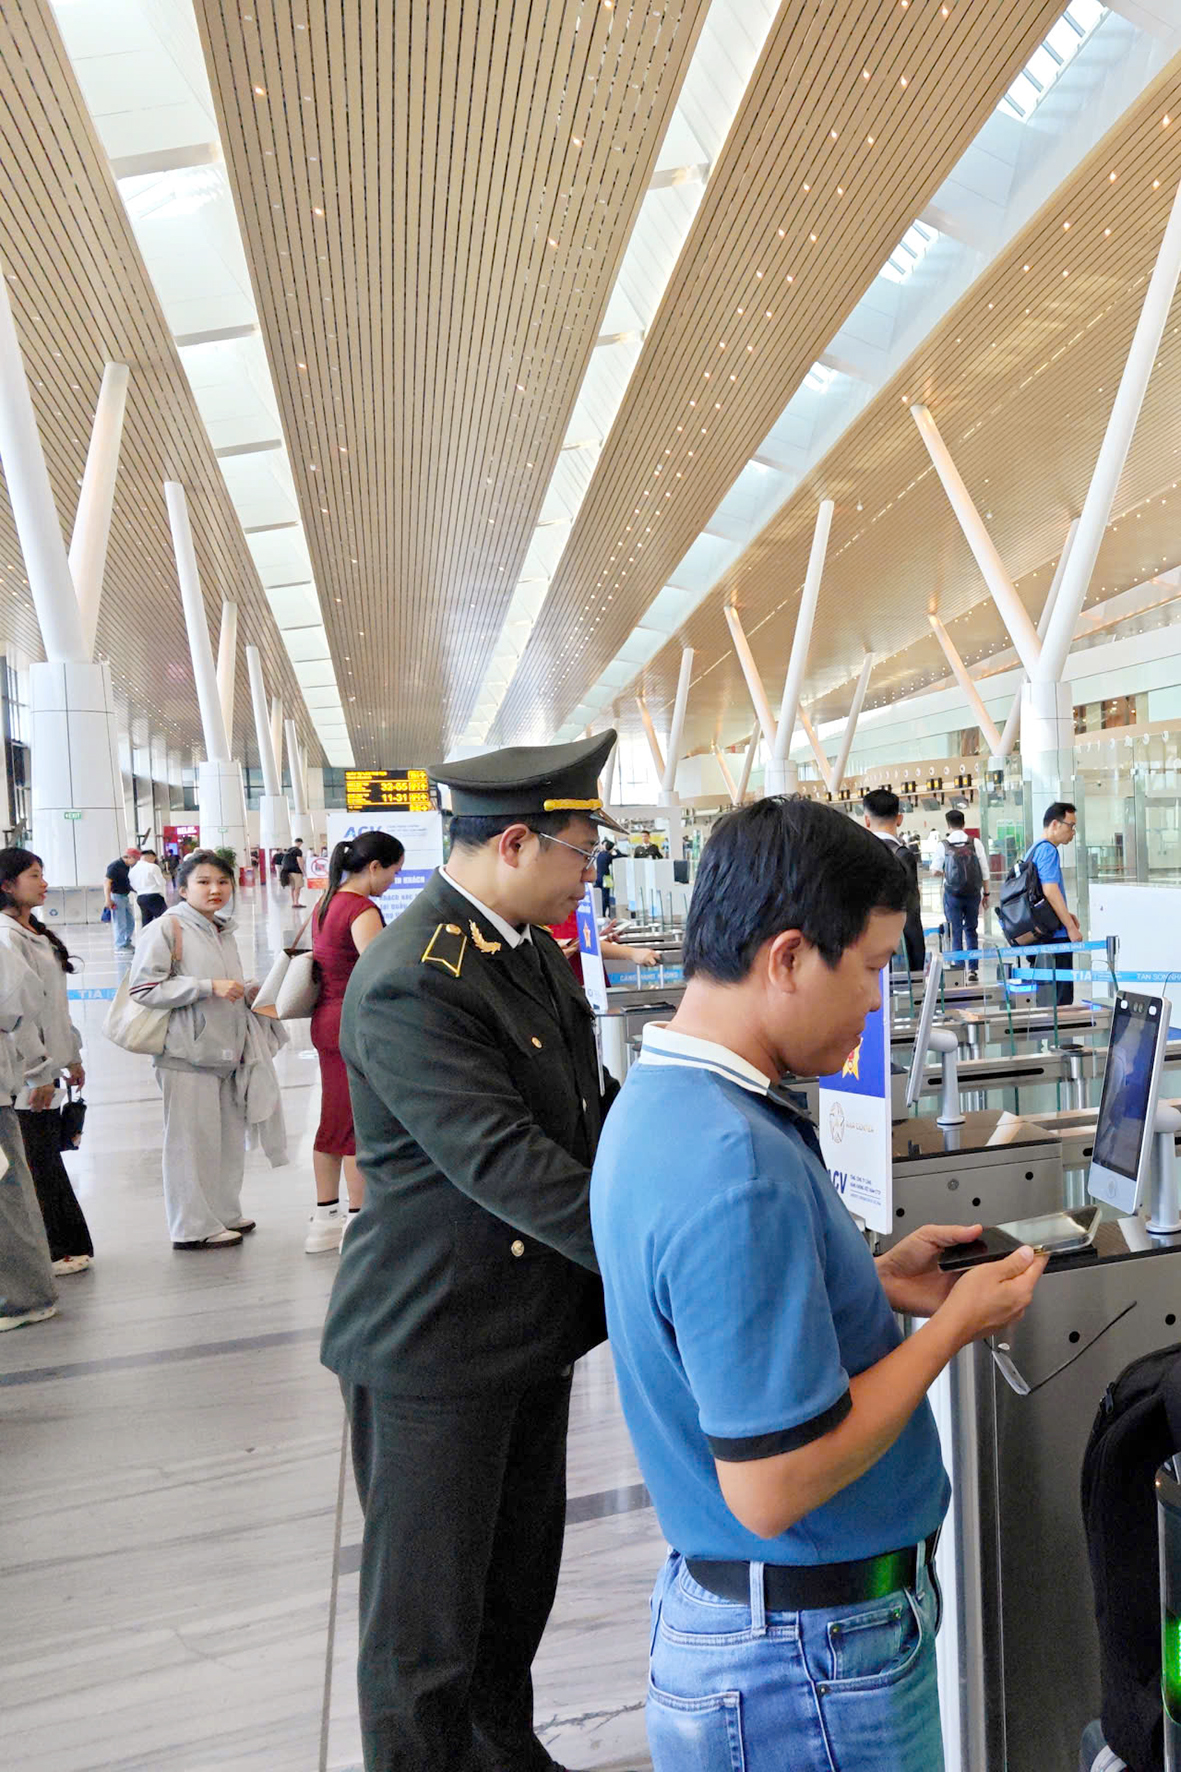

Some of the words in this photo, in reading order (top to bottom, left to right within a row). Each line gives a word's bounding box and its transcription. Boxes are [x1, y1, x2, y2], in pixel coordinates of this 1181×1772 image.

[380, 782, 408, 791] 32-55
[381, 793, 408, 802] 11-31
[1071, 970, 1092, 982] TIA
[79, 989, 102, 999] TIA
